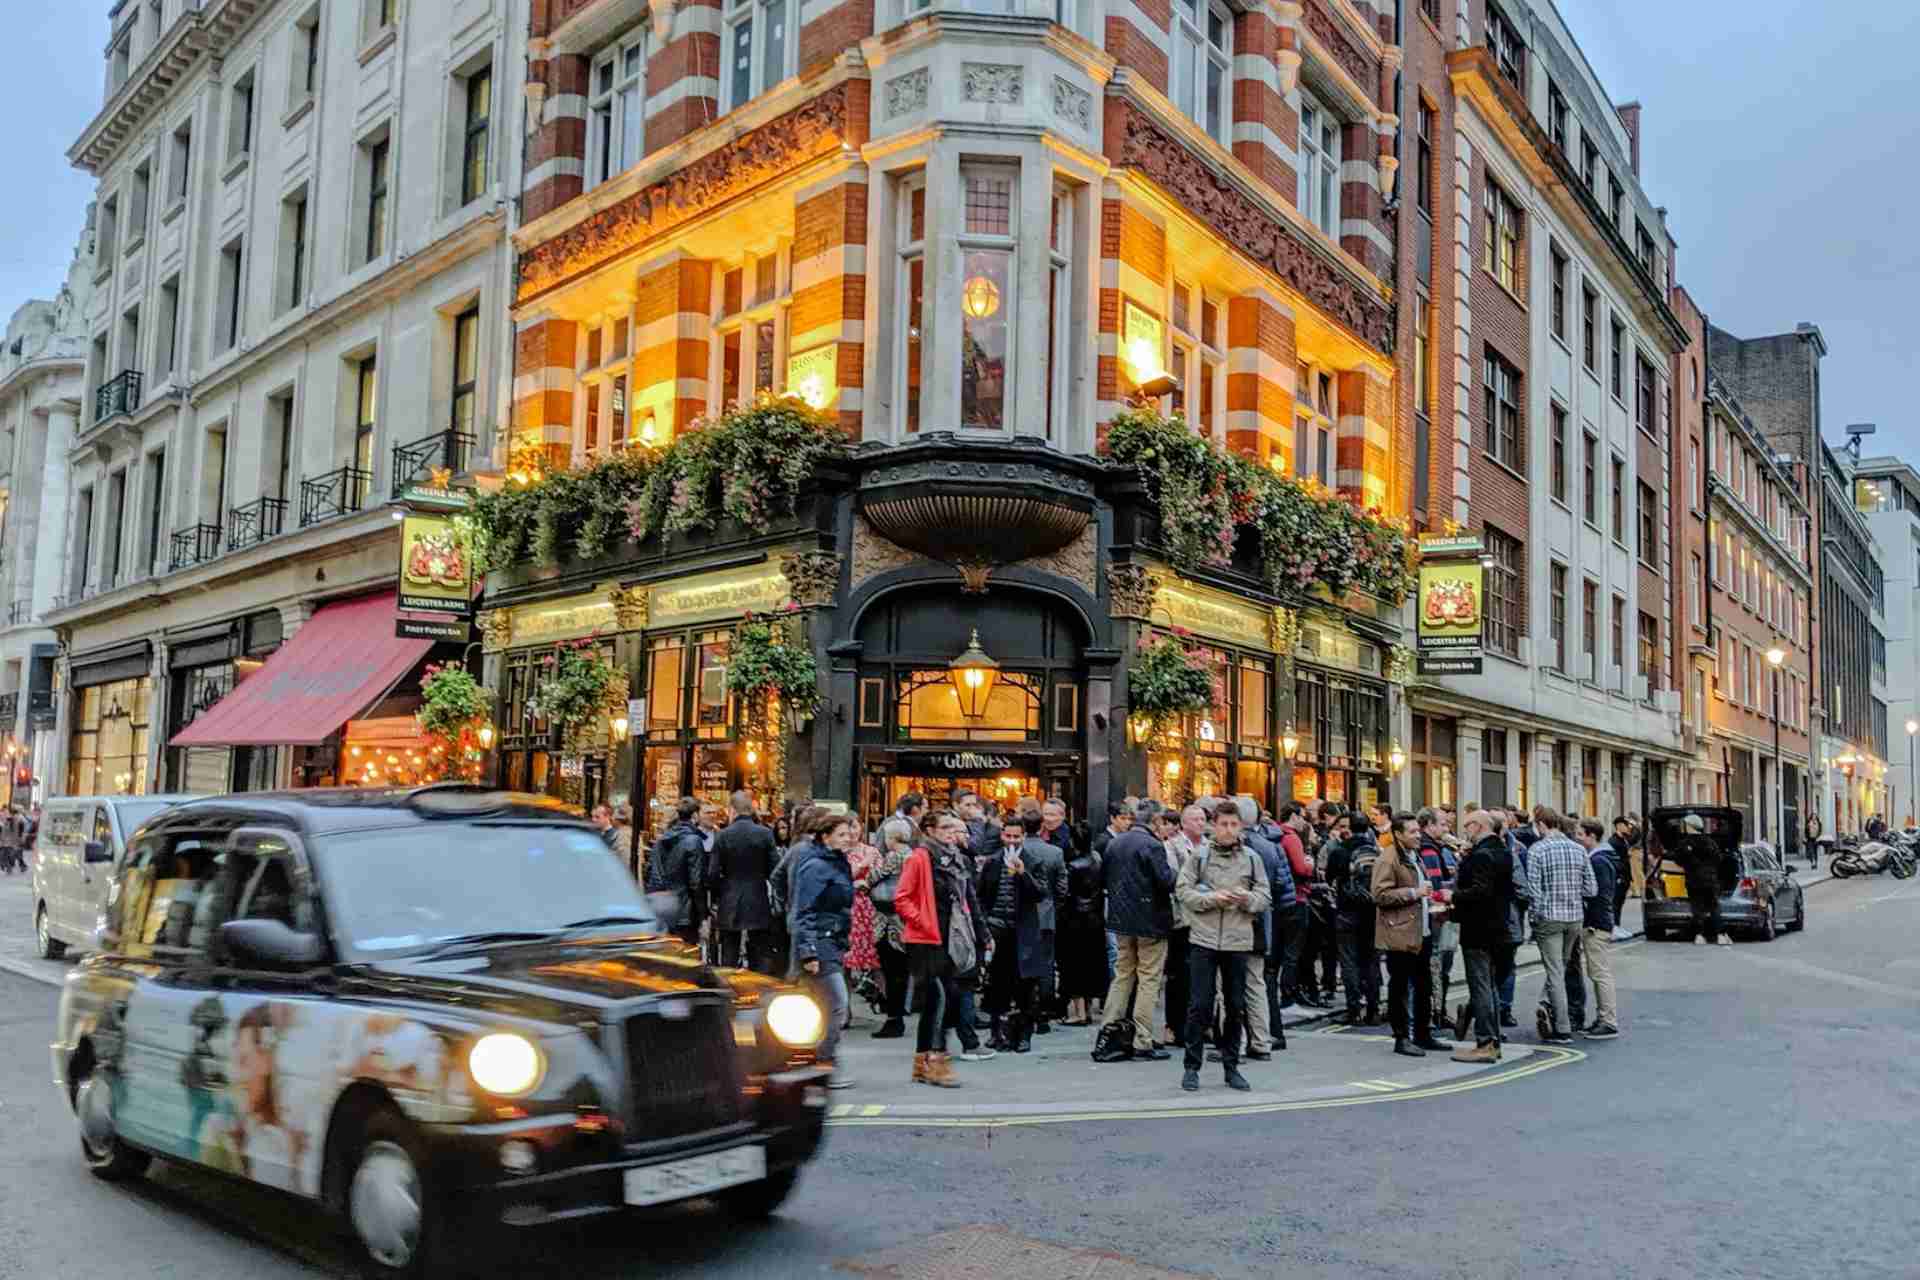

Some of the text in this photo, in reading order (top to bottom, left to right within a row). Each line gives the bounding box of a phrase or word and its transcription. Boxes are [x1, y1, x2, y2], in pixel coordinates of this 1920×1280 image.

[403, 596, 465, 609] LEICESTER ARMS
[1422, 636, 1478, 647] LEICESTER ARMS
[943, 751, 1012, 770] GUINNESS
